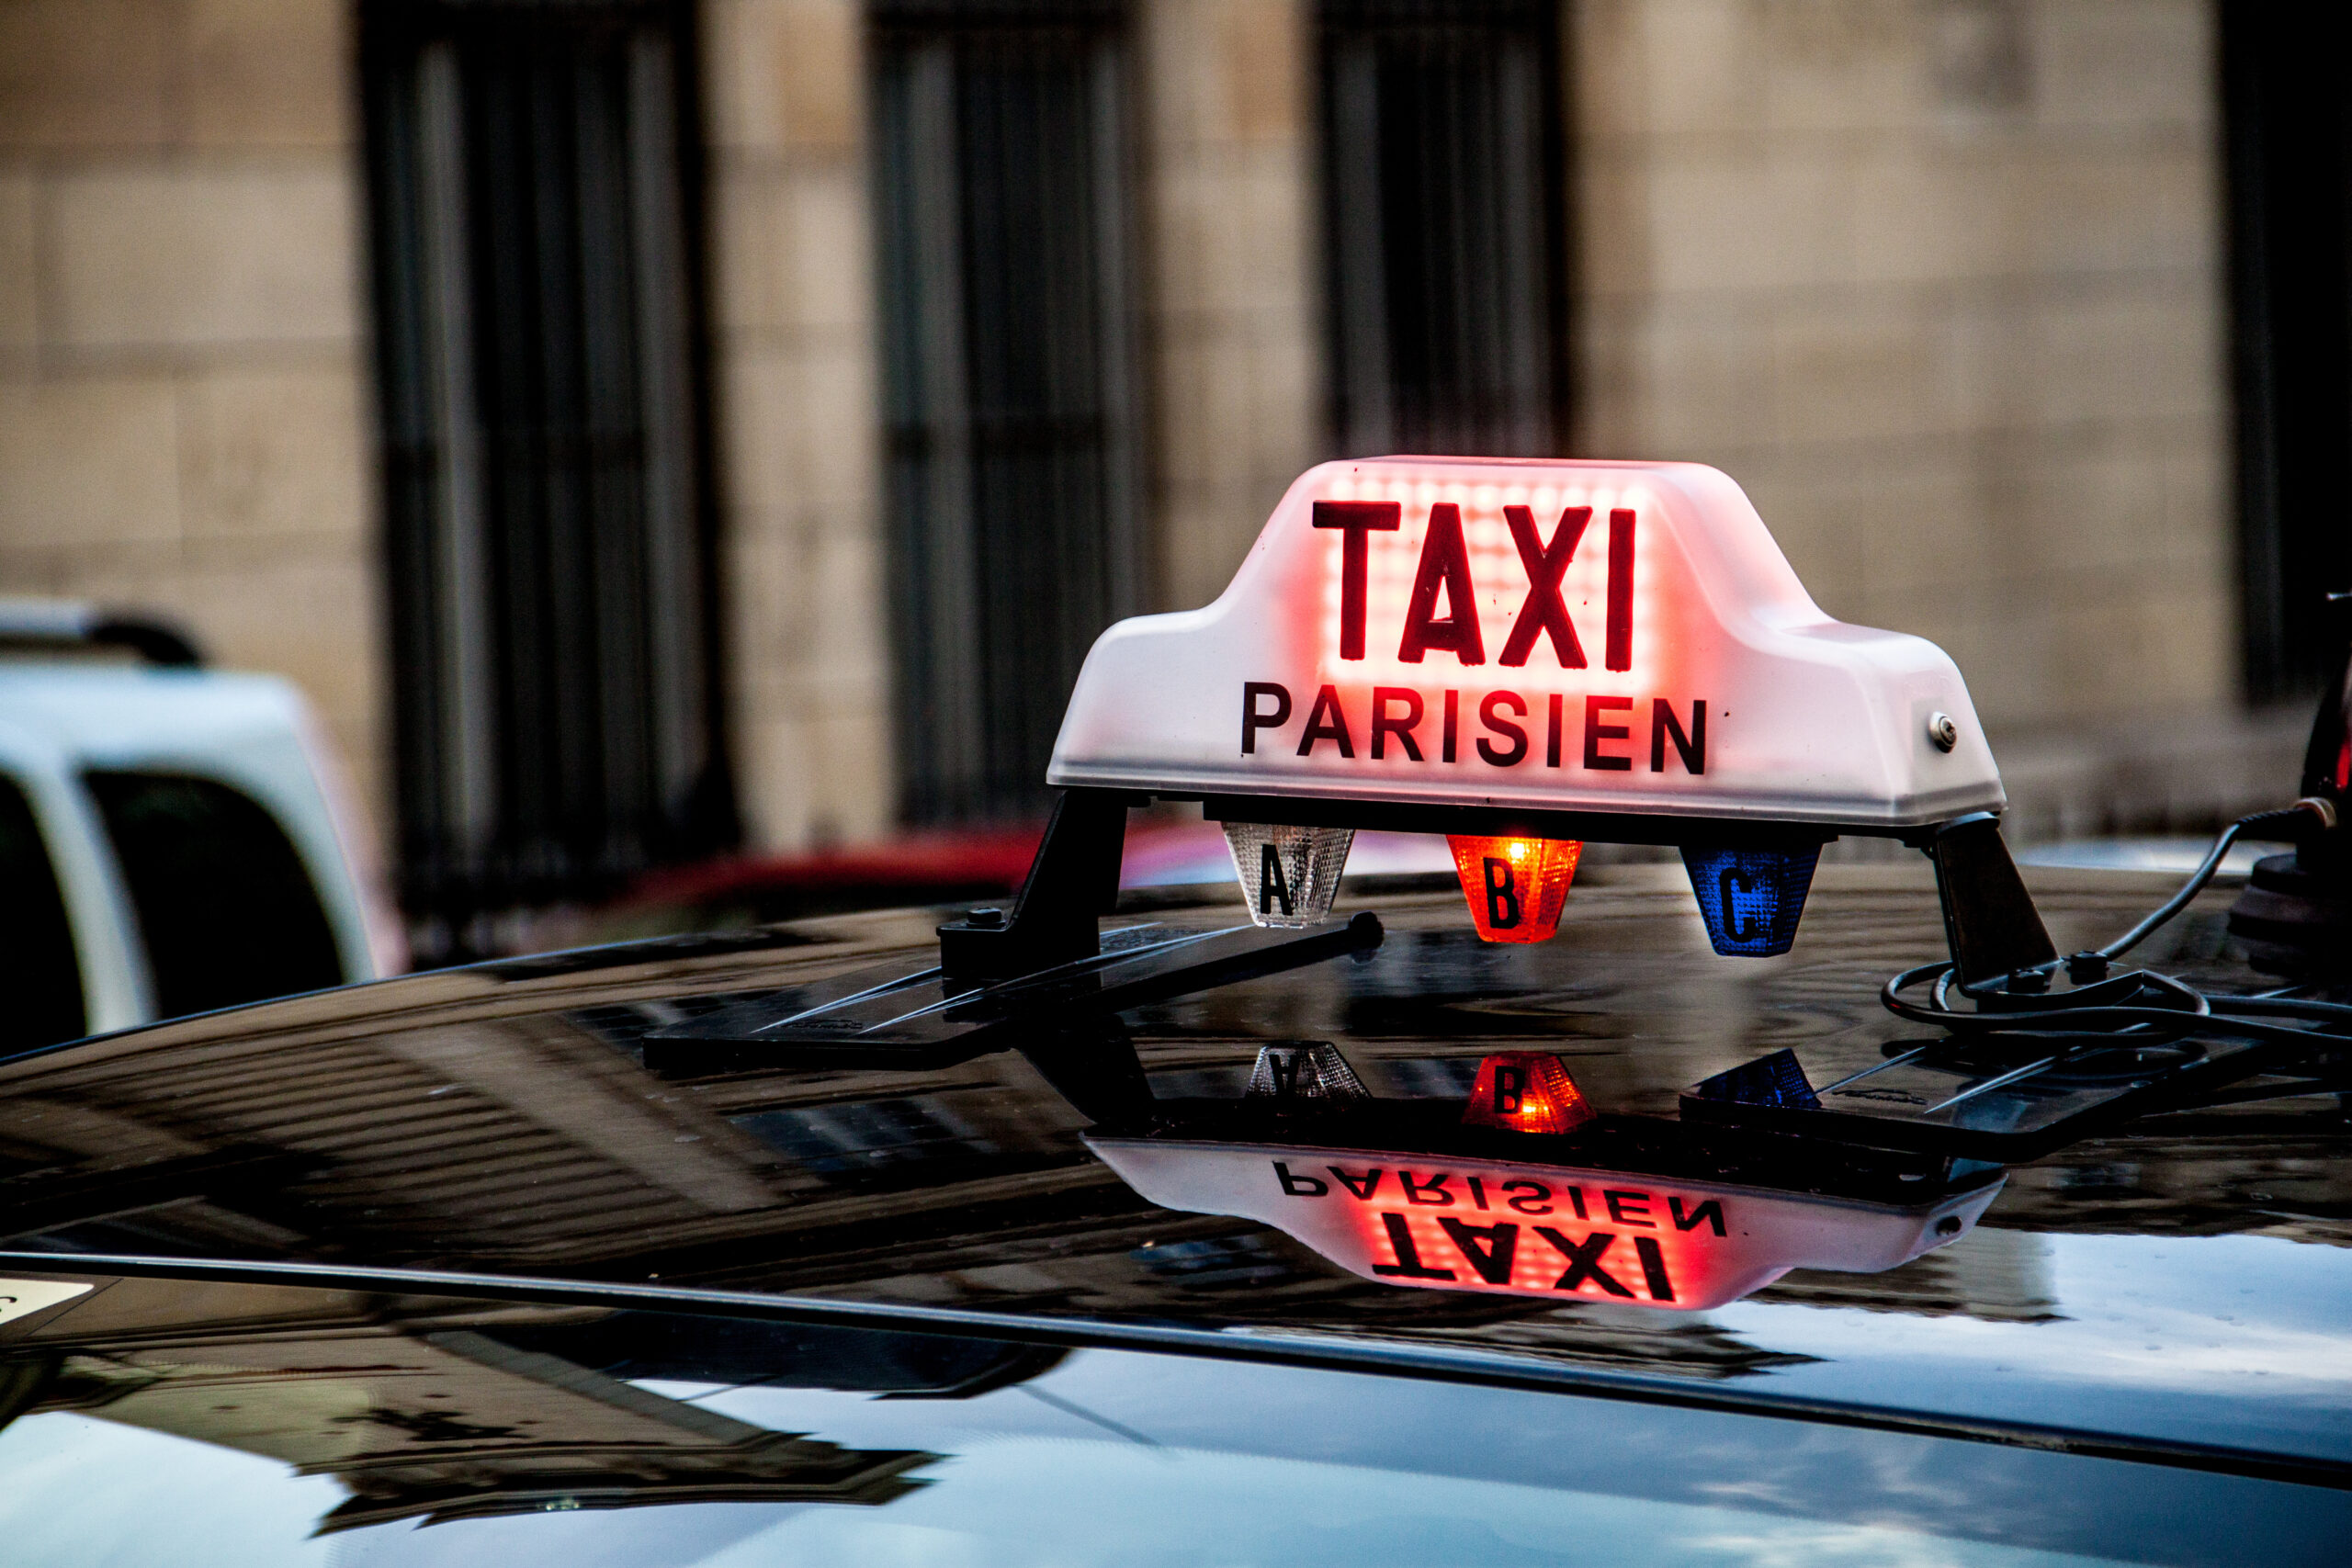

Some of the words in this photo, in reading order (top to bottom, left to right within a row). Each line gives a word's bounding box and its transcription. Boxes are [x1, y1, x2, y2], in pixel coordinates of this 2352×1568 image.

[1312, 500, 1636, 672] TAXI
[1241, 681, 1707, 775] PARISIEN
[1260, 843, 1294, 917] A
[1483, 856, 1523, 930] B
[1718, 866, 1753, 943] C
